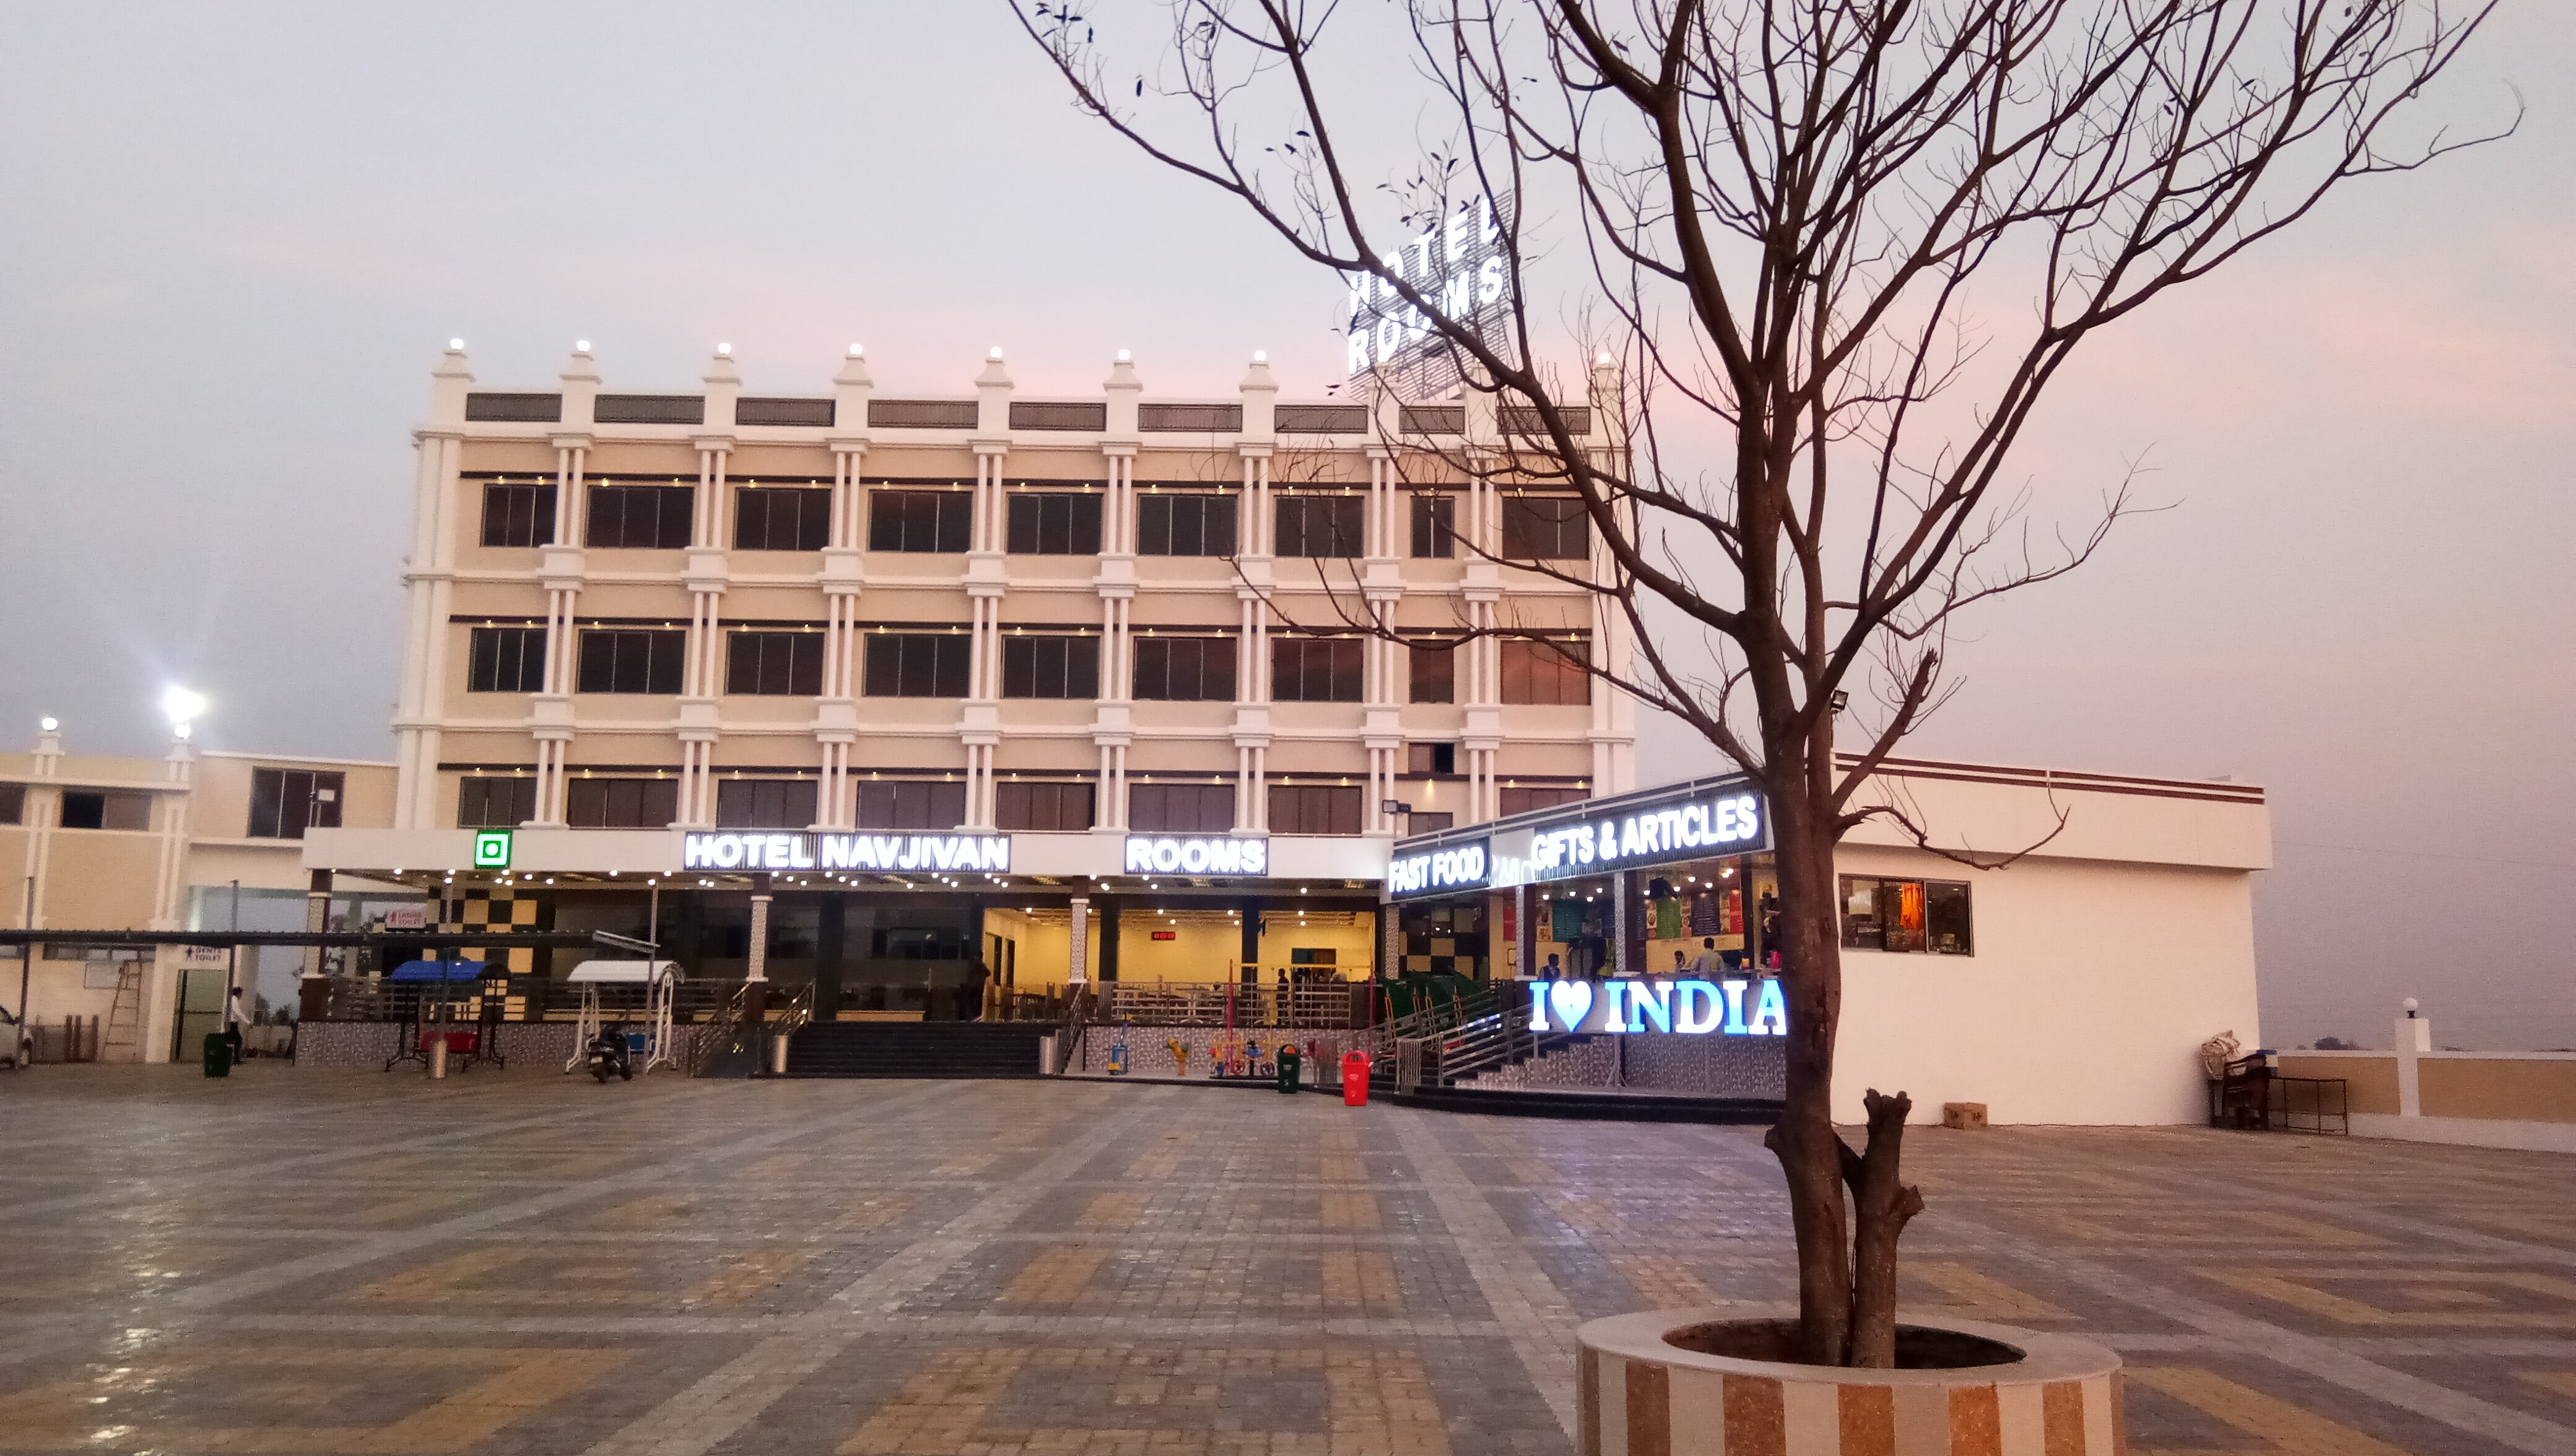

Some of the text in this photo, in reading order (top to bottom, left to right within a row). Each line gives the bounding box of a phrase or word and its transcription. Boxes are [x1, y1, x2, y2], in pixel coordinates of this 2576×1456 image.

[685, 835, 1008, 870] HOTEL NAVJIVAN
[1126, 839, 1266, 872] ROOMS
[1531, 795, 1758, 871] GIFTS & ARTICLES
[1388, 856, 1431, 893] FAST
[1432, 846, 1484, 886] FOOD
[1529, 980, 1788, 1036] I INDIA
